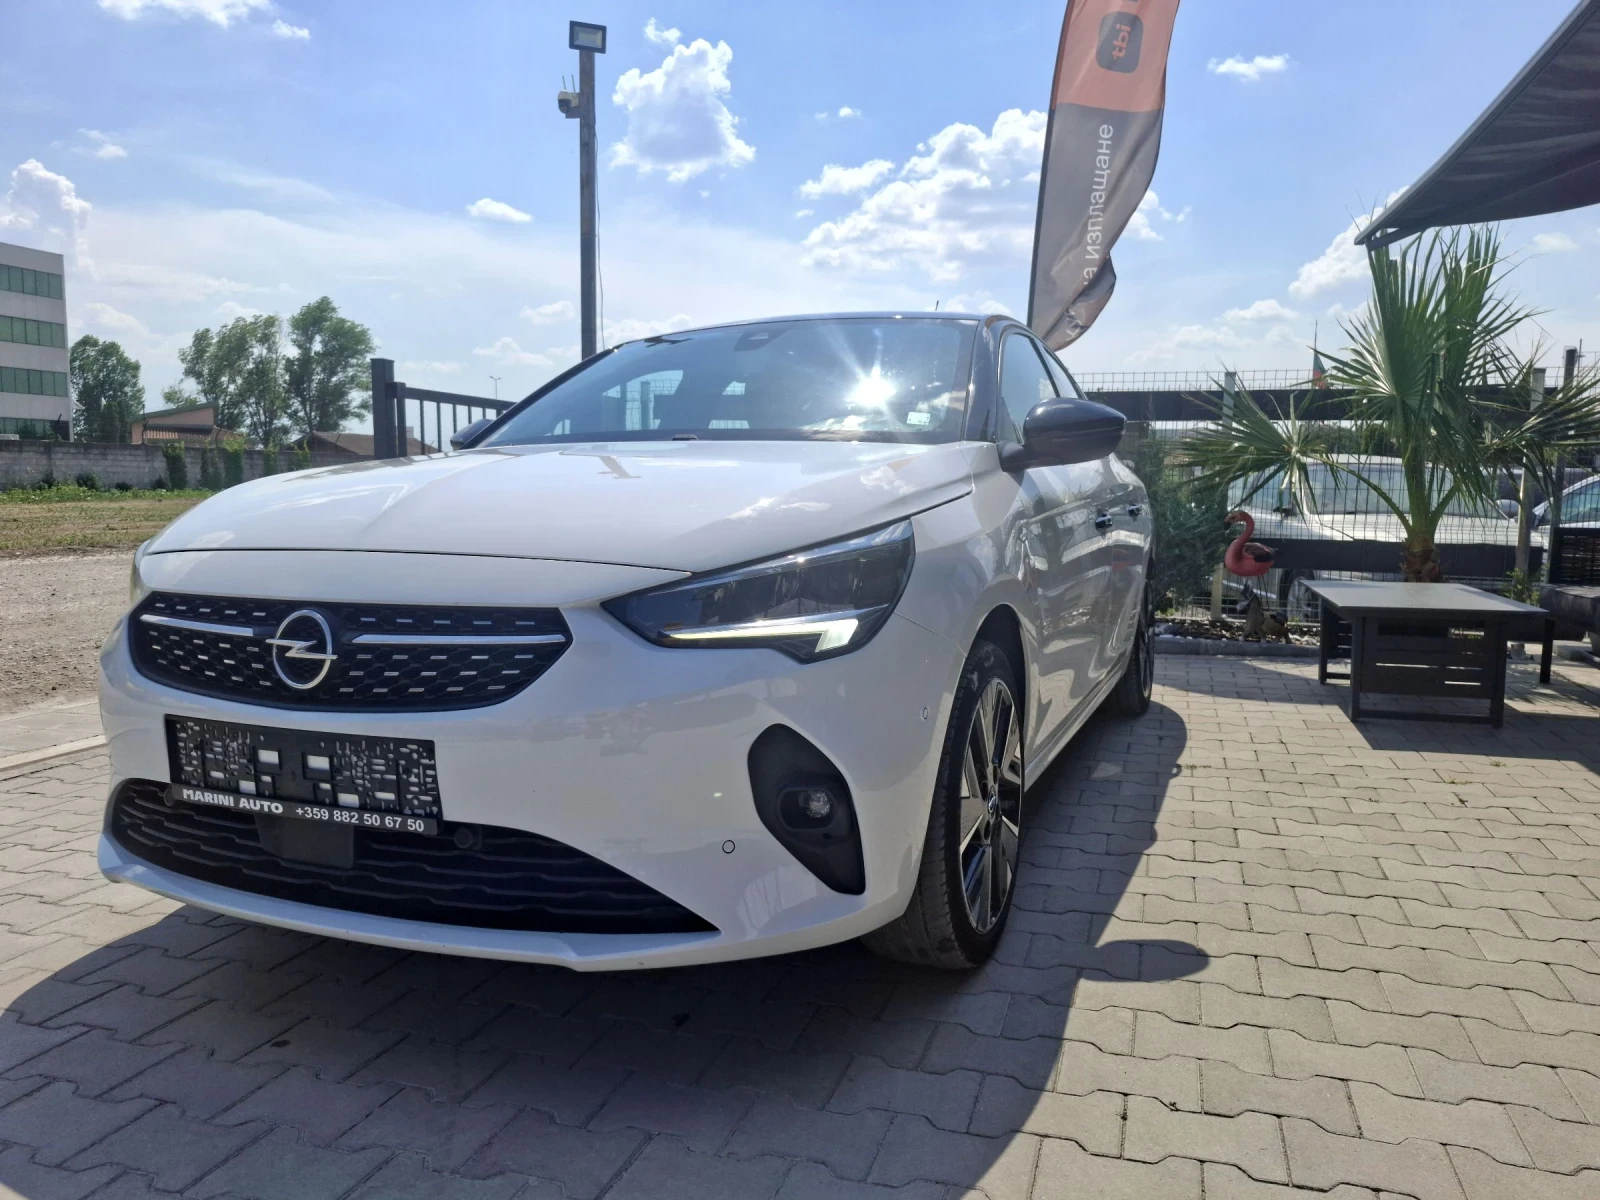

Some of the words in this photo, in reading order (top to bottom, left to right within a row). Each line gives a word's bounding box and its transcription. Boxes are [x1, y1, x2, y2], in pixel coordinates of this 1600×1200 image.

[1111, 23, 1131, 60] tbi
[1086, 123, 1114, 259] изплащане
[1083, 267, 1098, 285] а
[182, 788, 235, 808] MARINI
[239, 797, 284, 815] AUTO
[295, 807, 330, 821] +359
[333, 809, 359, 825] 882
[363, 812, 381, 828] 50
[385, 815, 403, 831] 67
[406, 818, 425, 833] 50
